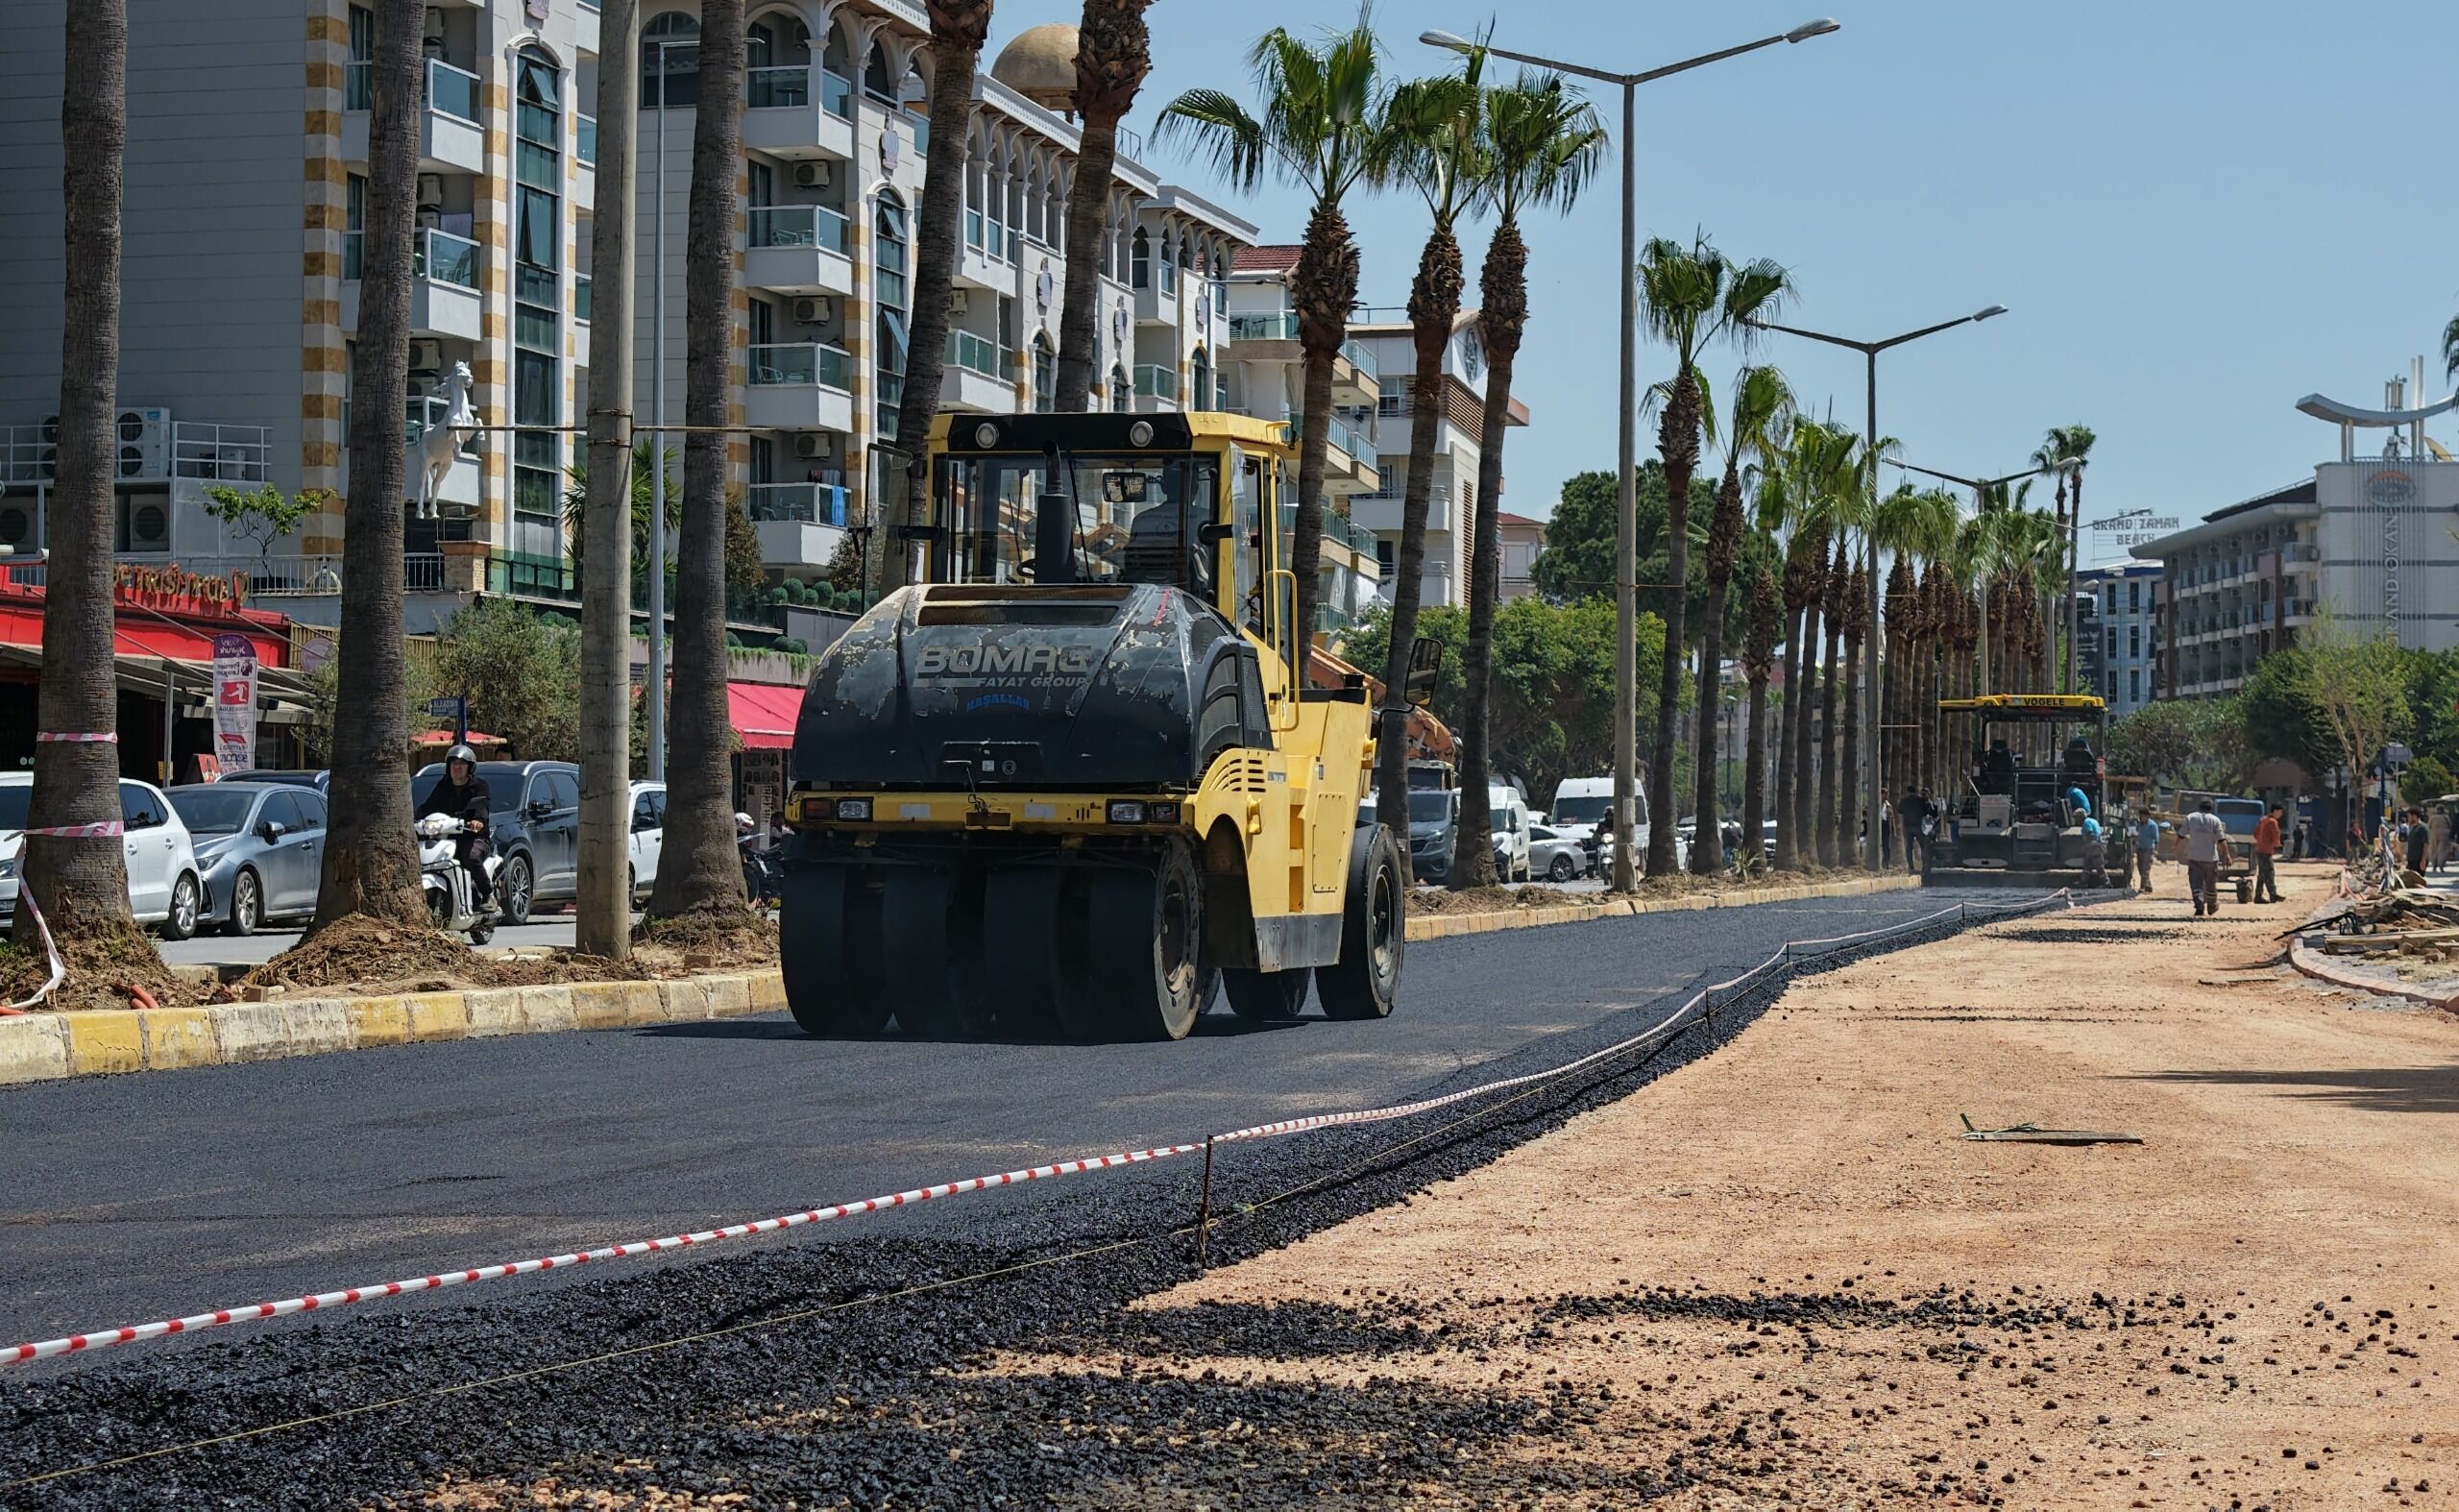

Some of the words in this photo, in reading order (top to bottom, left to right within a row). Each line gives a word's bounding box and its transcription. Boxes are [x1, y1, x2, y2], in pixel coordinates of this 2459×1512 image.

[2139, 517, 2179, 529] ZAMAN
[2116, 533, 2155, 546] BEACH
[2384, 513, 2398, 572] OKAN
[915, 645, 1093, 673] BOMAG
[978, 676, 1029, 688] FAYAT
[1030, 676, 1089, 688] GROUP
